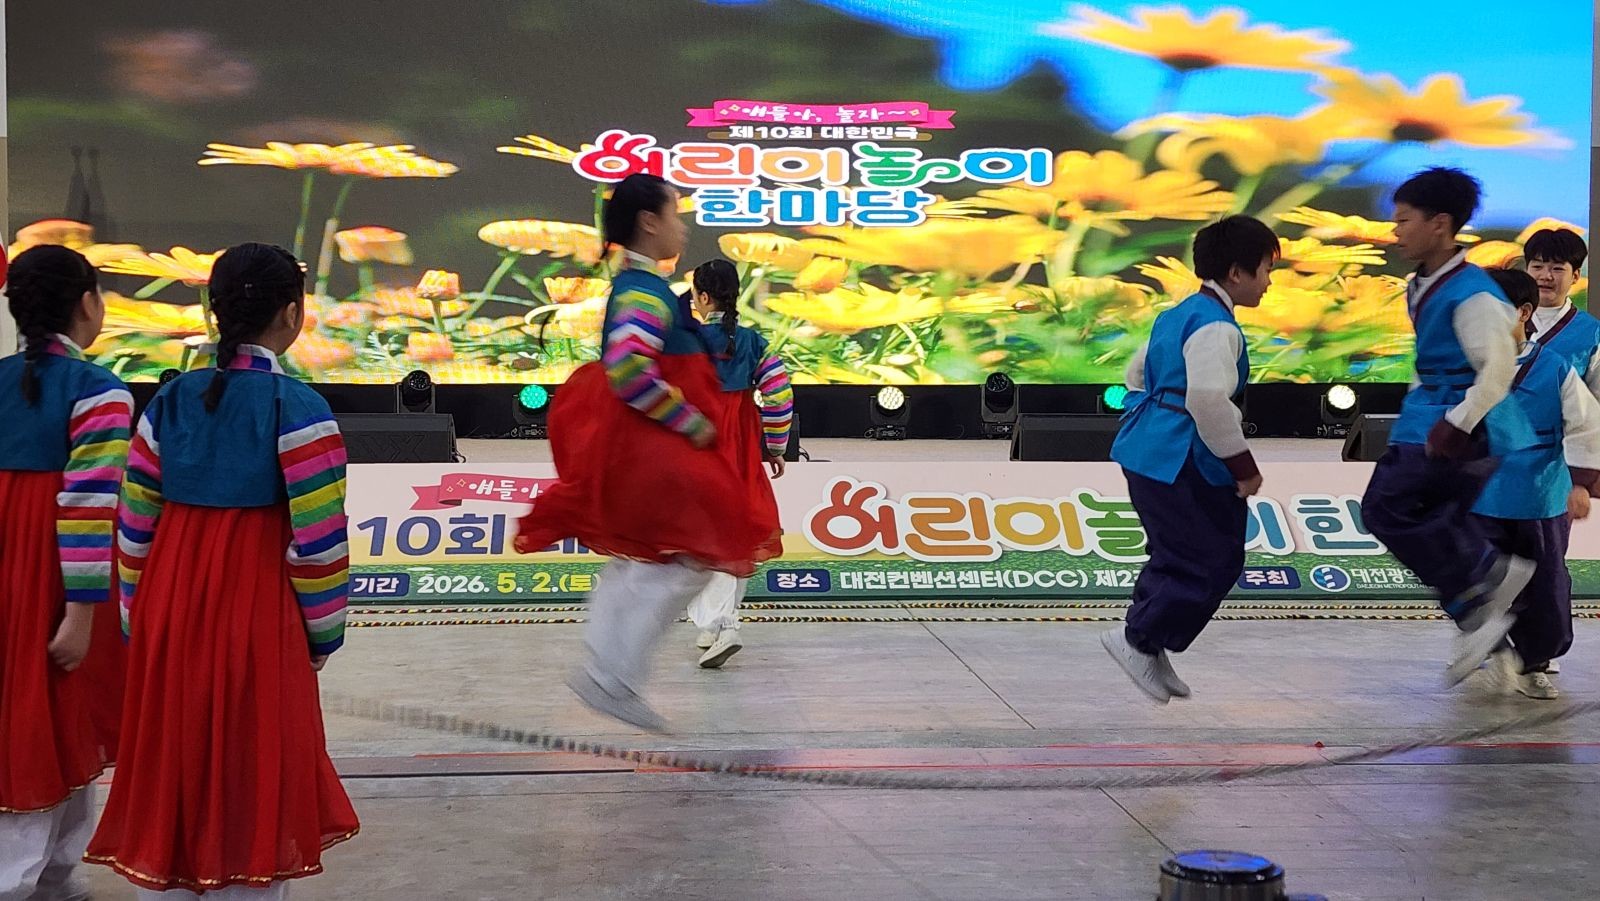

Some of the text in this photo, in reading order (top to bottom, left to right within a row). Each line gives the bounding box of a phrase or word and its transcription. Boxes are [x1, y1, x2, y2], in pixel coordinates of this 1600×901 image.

[729, 126, 919, 140] 제10회 대한민국
[698, 188, 938, 224] 한마당
[468, 478, 544, 500] 얘들아
[346, 513, 506, 557] 10회
[353, 577, 400, 594] 기간
[417, 574, 490, 594] 2026.
[777, 572, 820, 589] 장소
[1244, 569, 1290, 586] 주최
